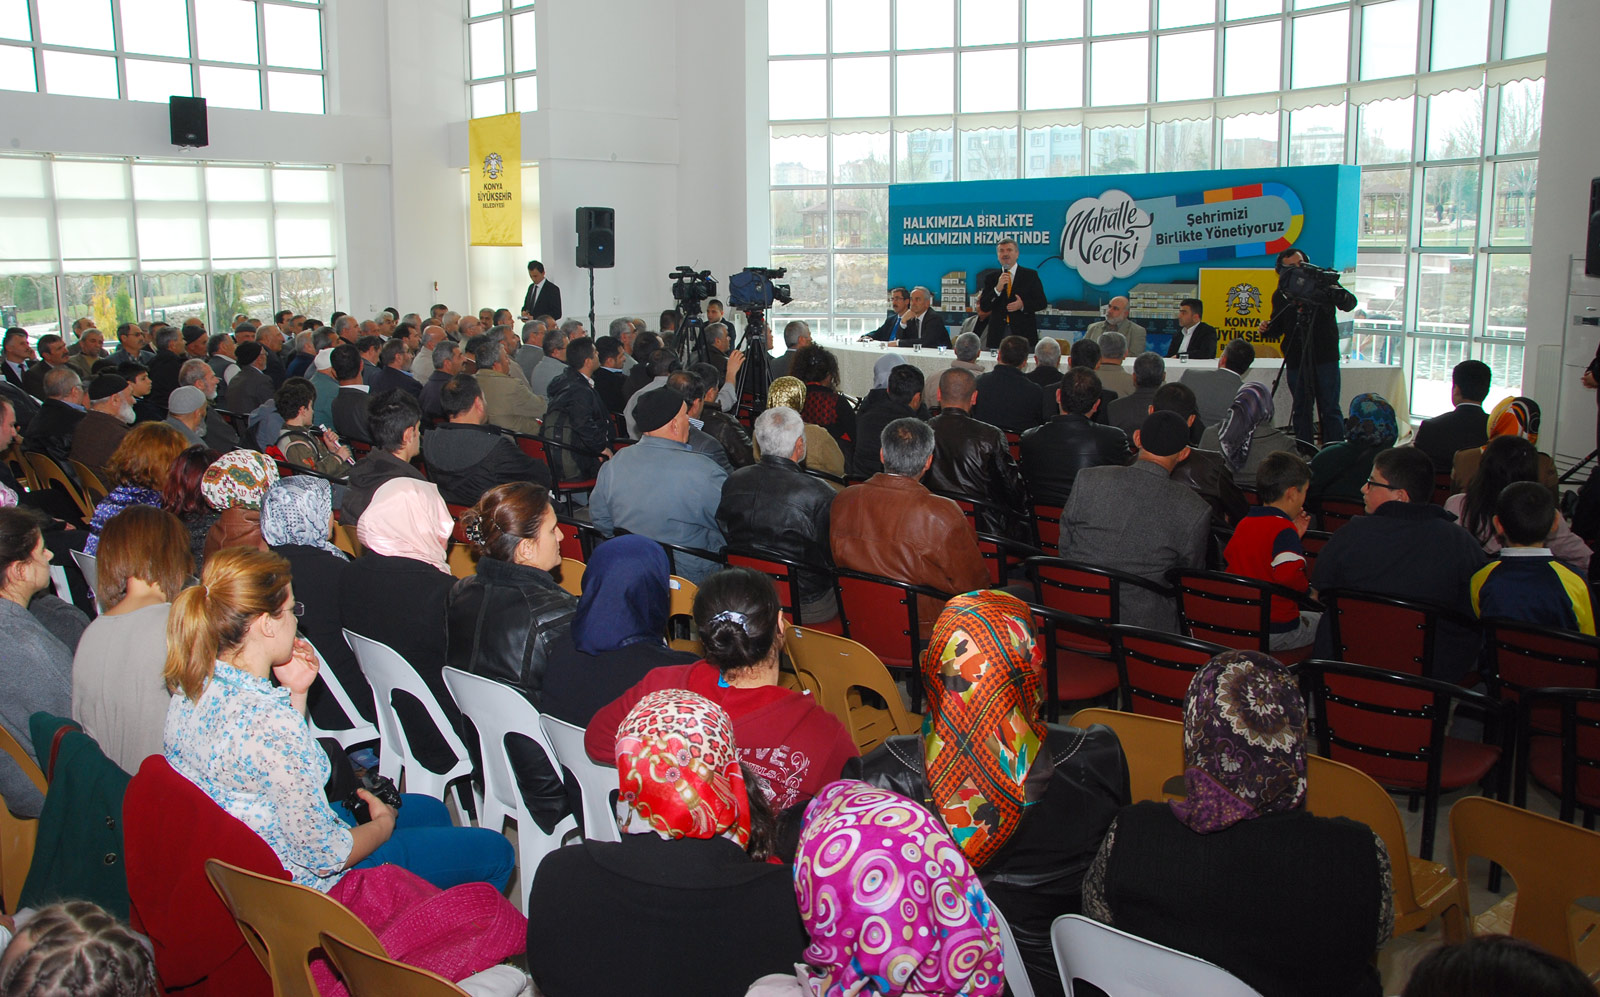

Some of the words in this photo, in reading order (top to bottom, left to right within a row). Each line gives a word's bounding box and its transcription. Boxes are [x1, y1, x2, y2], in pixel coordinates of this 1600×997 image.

[903, 215, 974, 229] HALKIMIZLA
[1187, 206, 1248, 227] Şehrimizi
[1060, 200, 1138, 259] Mahalle
[1156, 230, 1203, 245] Birlikte
[1205, 221, 1285, 240] Yönetiyoruz
[903, 232, 971, 245] HALKIMIZIN
[1225, 317, 1261, 328] KONYA
